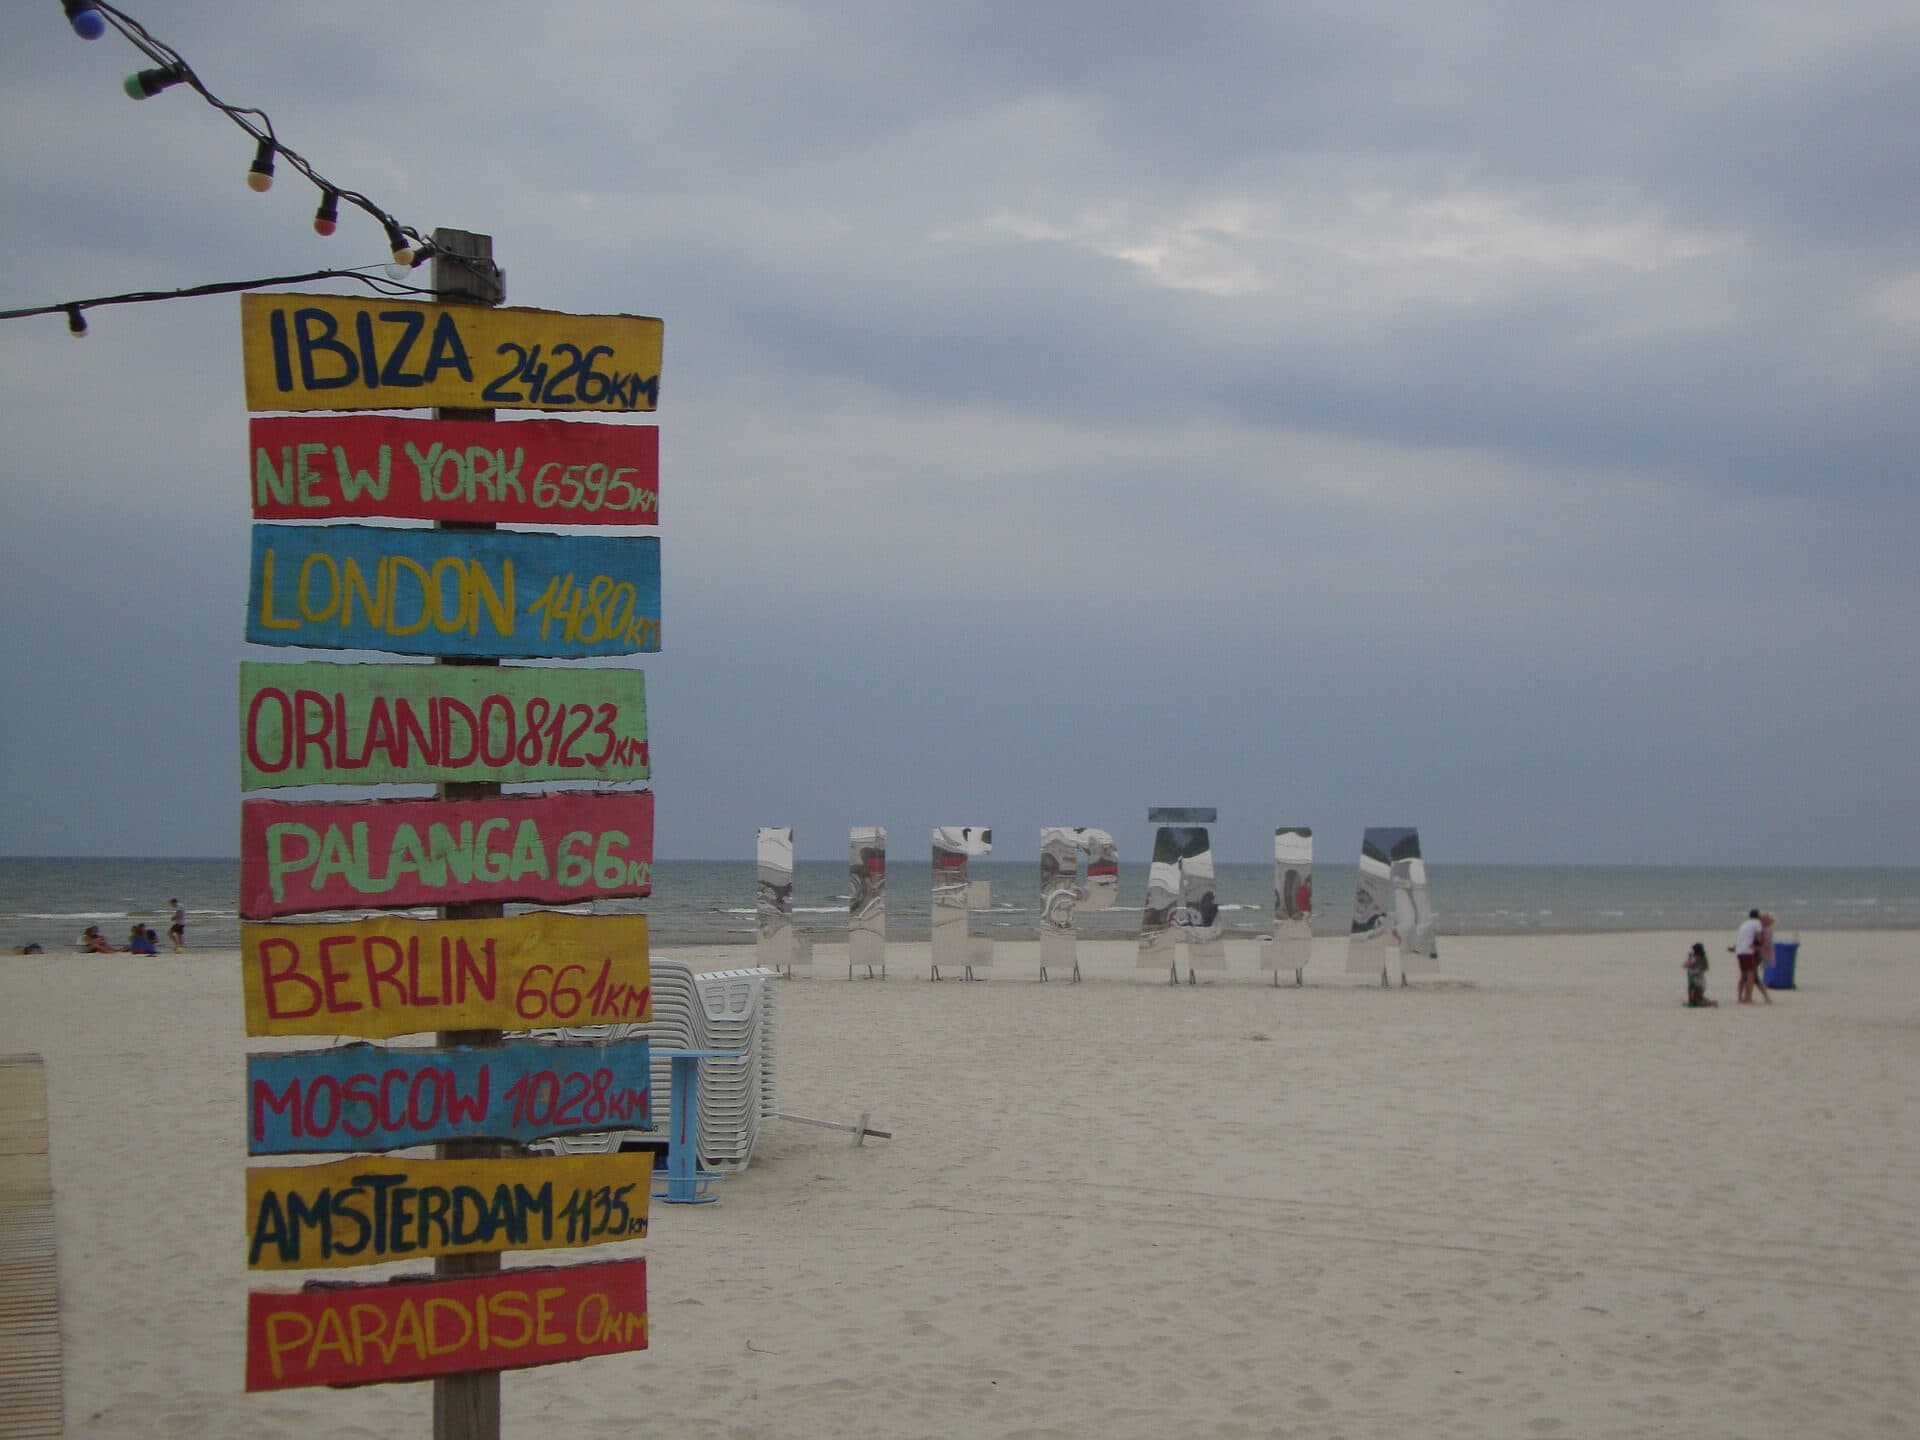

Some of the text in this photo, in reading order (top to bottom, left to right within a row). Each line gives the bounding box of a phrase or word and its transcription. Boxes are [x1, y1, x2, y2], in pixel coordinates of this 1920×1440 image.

[270, 308, 474, 391] IBIZA
[256, 443, 391, 507] NEW
[405, 442, 525, 503] YORK
[261, 548, 514, 637] LONDON
[246, 687, 516, 773] ORLANDO
[266, 817, 550, 903] PALANGA
[259, 935, 497, 1019] BERLIN
[253, 1064, 489, 1142] MOSCOW
[249, 1174, 552, 1264] AMSTERDAM
[266, 1287, 567, 1379] PARADISE
